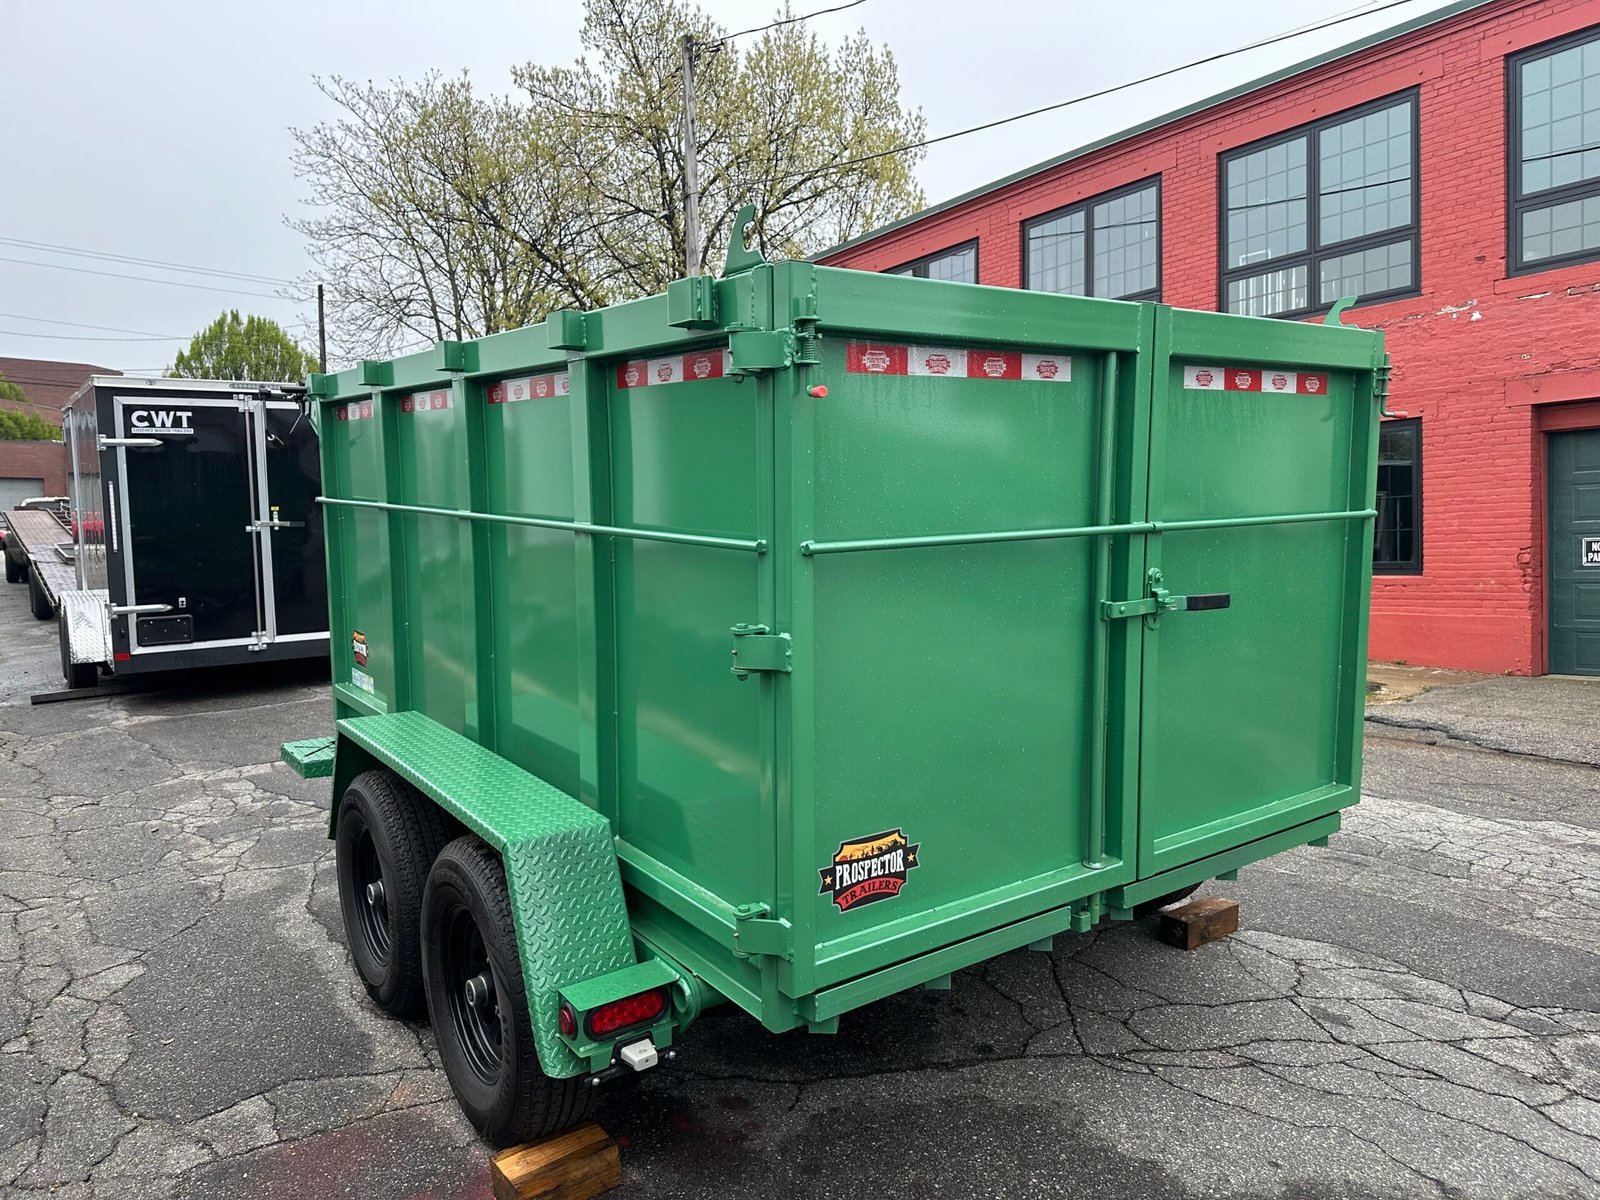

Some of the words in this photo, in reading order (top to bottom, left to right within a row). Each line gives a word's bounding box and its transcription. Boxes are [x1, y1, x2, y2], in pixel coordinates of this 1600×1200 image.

[131, 410, 192, 427] CWT
[835, 848, 905, 891] PROSPECTOR
[842, 880, 899, 905] TRAILERS
